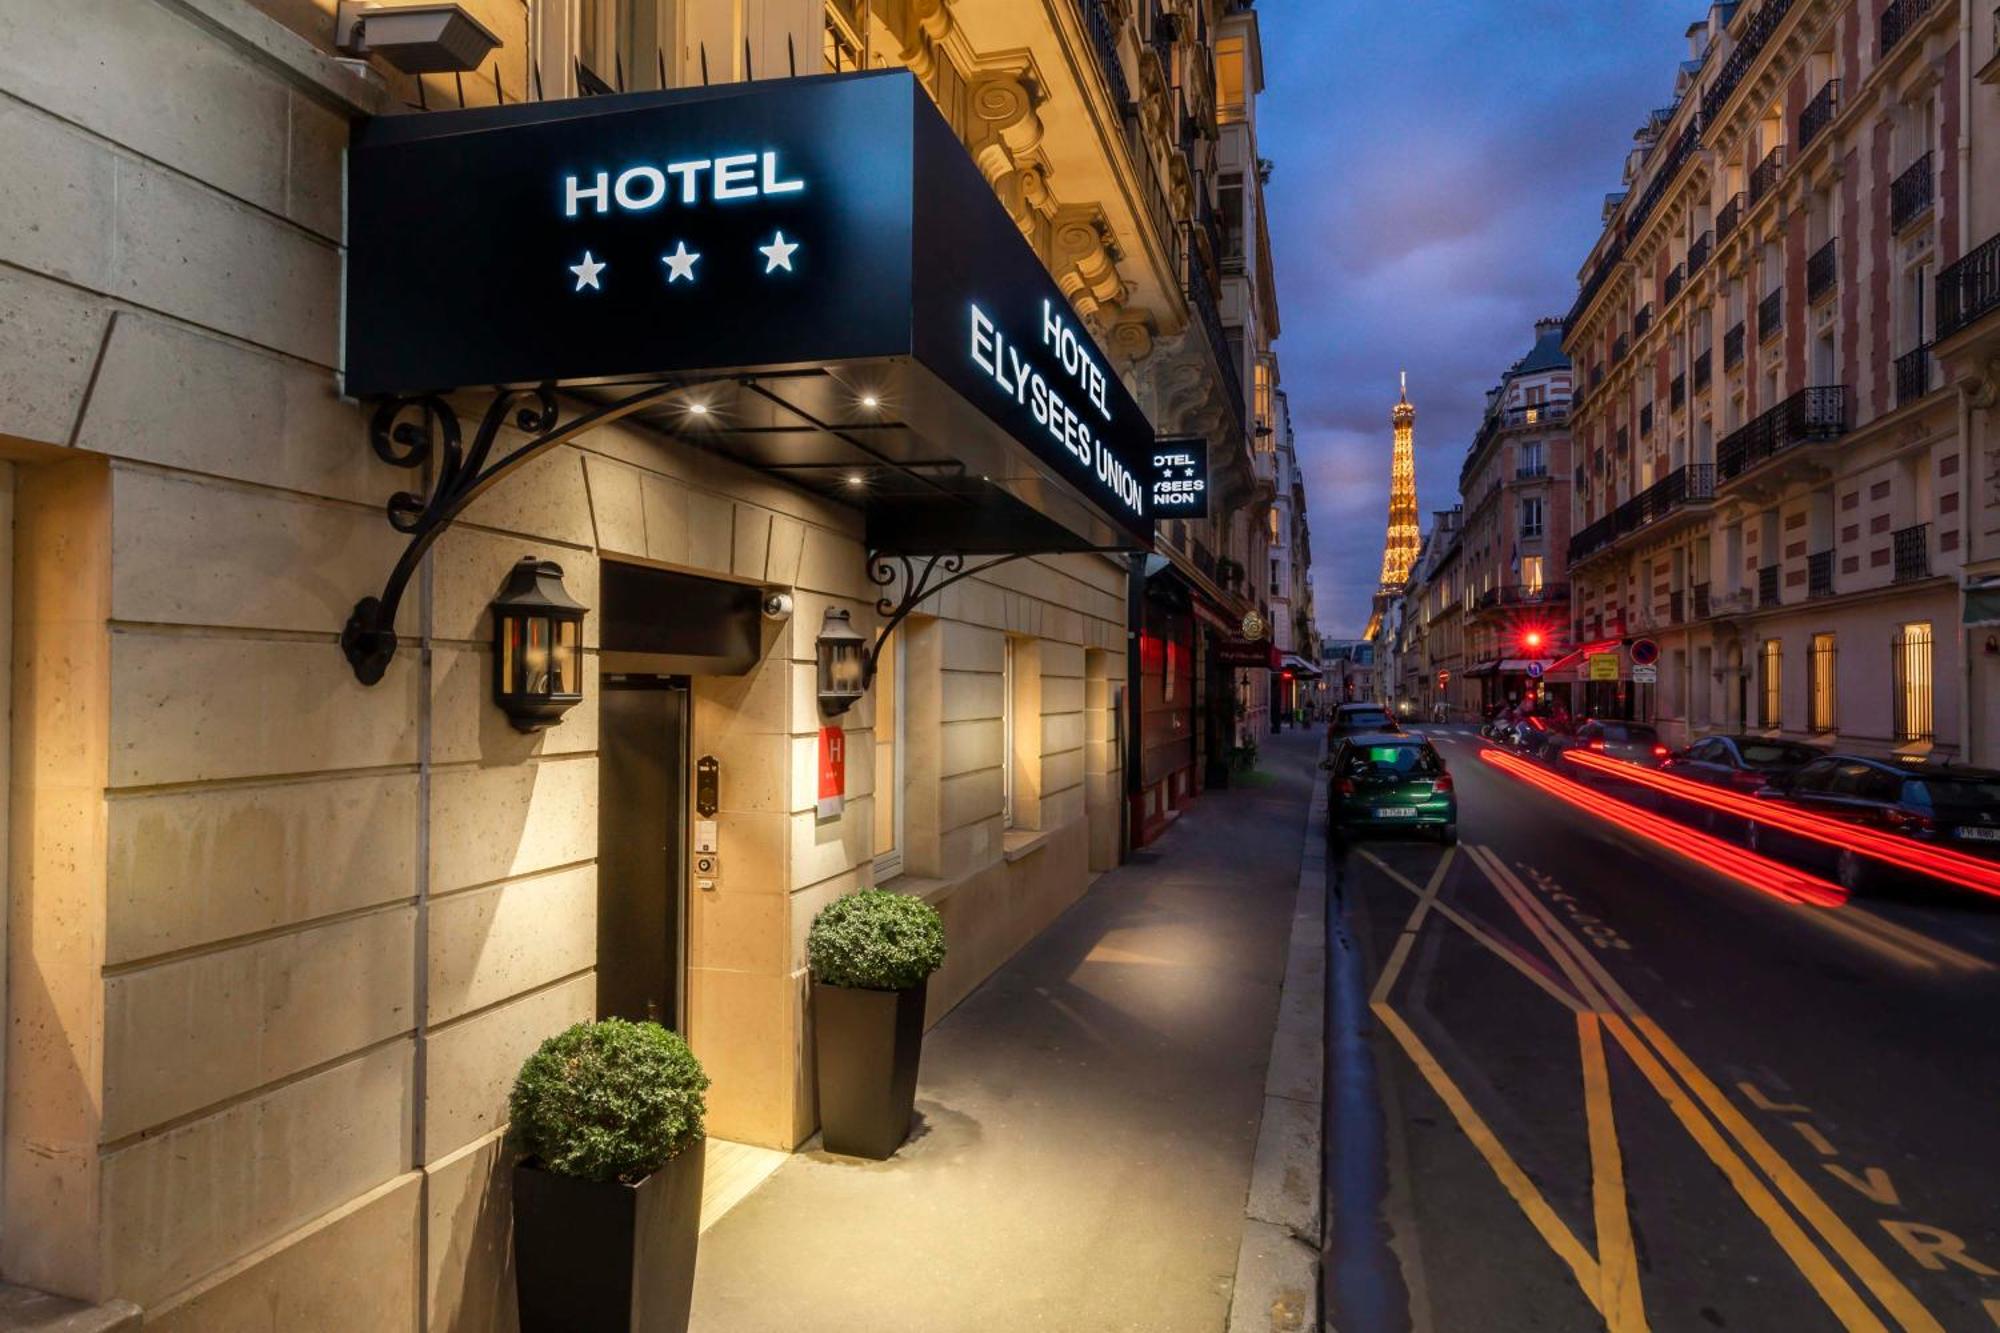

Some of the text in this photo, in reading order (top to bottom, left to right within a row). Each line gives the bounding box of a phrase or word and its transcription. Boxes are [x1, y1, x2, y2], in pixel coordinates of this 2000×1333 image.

[566, 151, 804, 216] HOTEL
[1044, 299, 1112, 421] HOTEL
[971, 304, 1142, 516] ELYSEES UNION
[1153, 454, 1195, 467] OTEL
[1153, 480, 1204, 492] YSEES
[1153, 493, 1194, 504] NION
[830, 737, 841, 763] H
